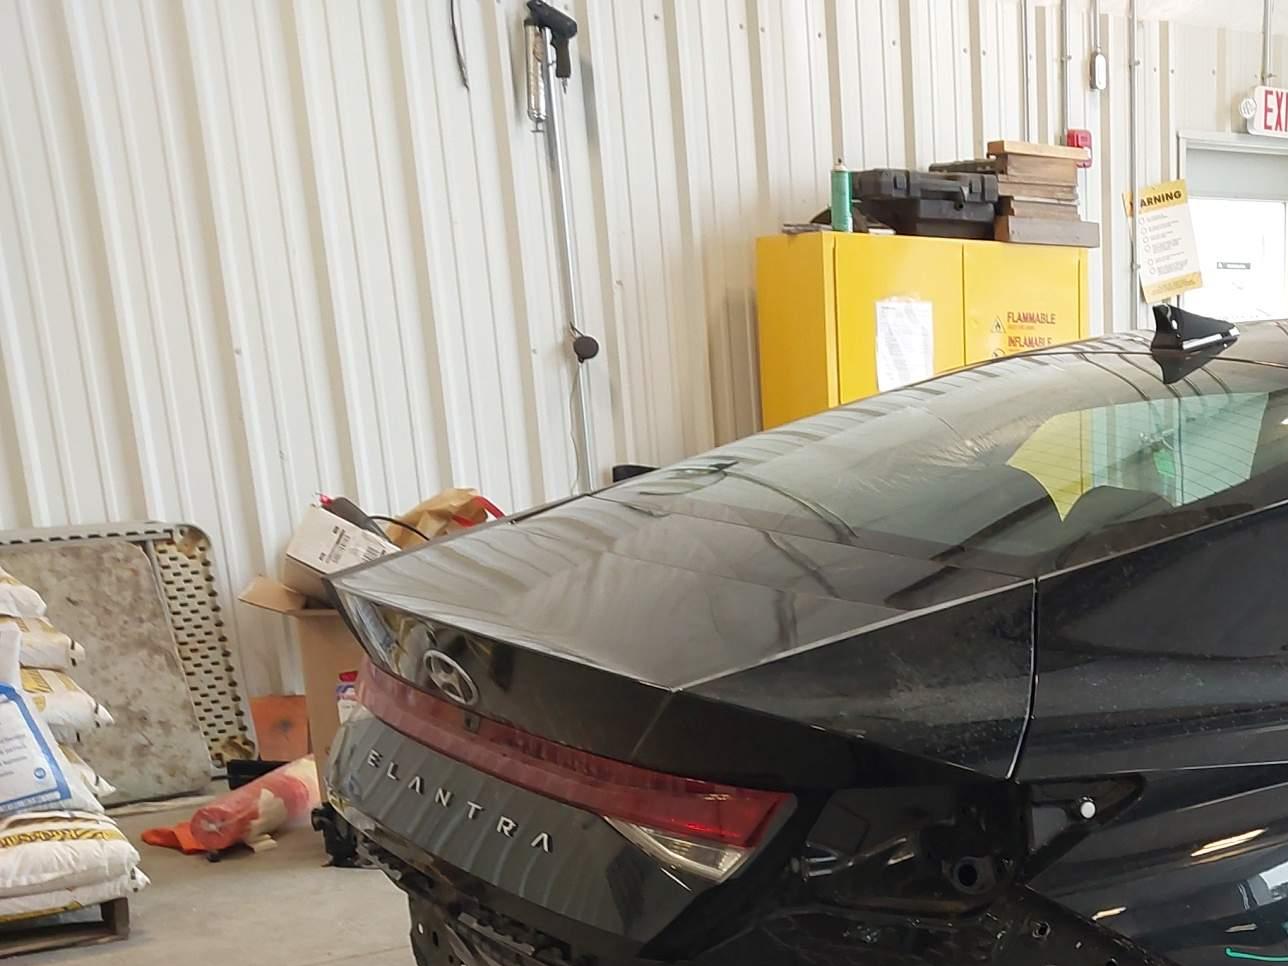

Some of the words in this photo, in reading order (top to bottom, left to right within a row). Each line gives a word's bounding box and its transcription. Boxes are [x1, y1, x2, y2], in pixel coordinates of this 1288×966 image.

[1131, 190, 1182, 208] ARNING
[1007, 311, 1056, 324] FLAMMABLE
[367, 749, 553, 853] ELANTRA
